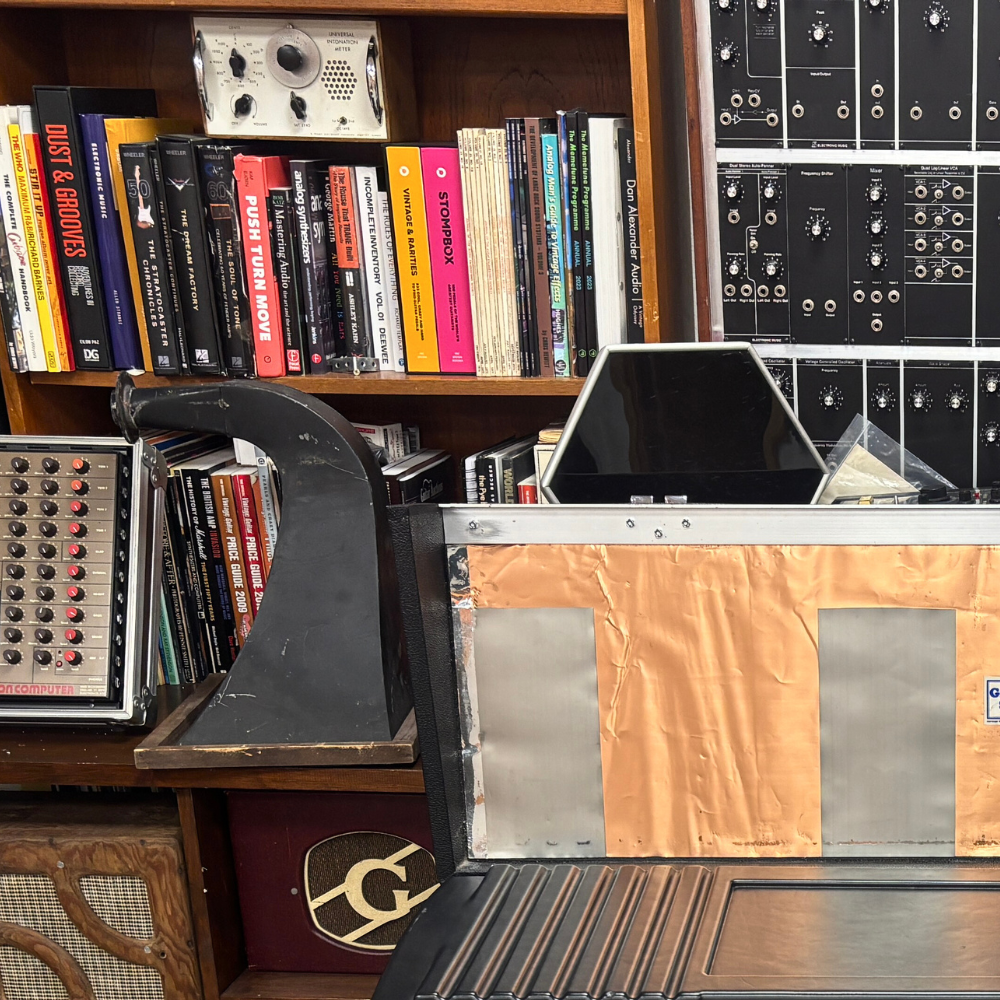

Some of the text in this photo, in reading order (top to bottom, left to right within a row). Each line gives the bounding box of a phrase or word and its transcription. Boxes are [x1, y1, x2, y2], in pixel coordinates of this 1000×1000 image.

[11, 135, 20, 152] THE
[15, 152, 24, 173] WHO
[545, 145, 554, 175] Analog
[3, 174, 11, 188] THE
[18, 175, 28, 214] MAXIMUM
[45, 124, 87, 257] DUST & GROOVES
[91, 143, 108, 219] ELECTRONIC MUSIC
[547, 177, 556, 203] Man's
[6, 191, 17, 230] COMPLETE
[294, 171, 311, 264] analog synthesizers
[341, 208, 349, 222] That
[549, 205, 558, 227] Guide
[571, 187, 579, 231] Programme
[582, 186, 590, 231] Programme
[275, 210, 287, 258] Mastering
[343, 223, 352, 245] TRANE
[383, 215, 391, 240] RULES
[403, 187, 413, 227] VINTAGE
[408, 238, 418, 276] RARITIES
[438, 191, 454, 265] STOMPBOX
[626, 180, 642, 294] Dan Alexander Audio
[180, 209, 199, 311] THE DREAM FACTORY
[386, 241, 392, 251] OF
[551, 240, 560, 274] Vintage
[228, 261, 236, 286] SOUL
[245, 195, 271, 341] PUSH TURN MOVE
[280, 260, 290, 289] Audio
[364, 177, 376, 233] INCOMPLETE
[370, 234, 381, 285] INVENTORY
[379, 327, 388, 364] DEEWEE
[19, 268, 31, 312] HANDBOOK
[34, 269, 45, 301] BARNES
[142, 260, 157, 327] CHRONICLES
[147, 240, 168, 347] THE STRATOCASTER
[231, 289, 239, 302] OF
[552, 275, 561, 304] Effects
[233, 305, 241, 330] TONE
[188, 489, 197, 515] HISTORY
[222, 498, 230, 519] Vintage
[479, 488, 487, 501] Pye
[193, 517, 198, 525] OF
[201, 478, 221, 558] THE BRITISH AMP INVASION
[225, 518, 233, 534] Guitar
[195, 525, 207, 560] Marshall
[226, 537, 239, 561] PRICE
[231, 564, 244, 588] GUIDE
[207, 602, 215, 621] YEARS
[235, 591, 247, 613] 2009
